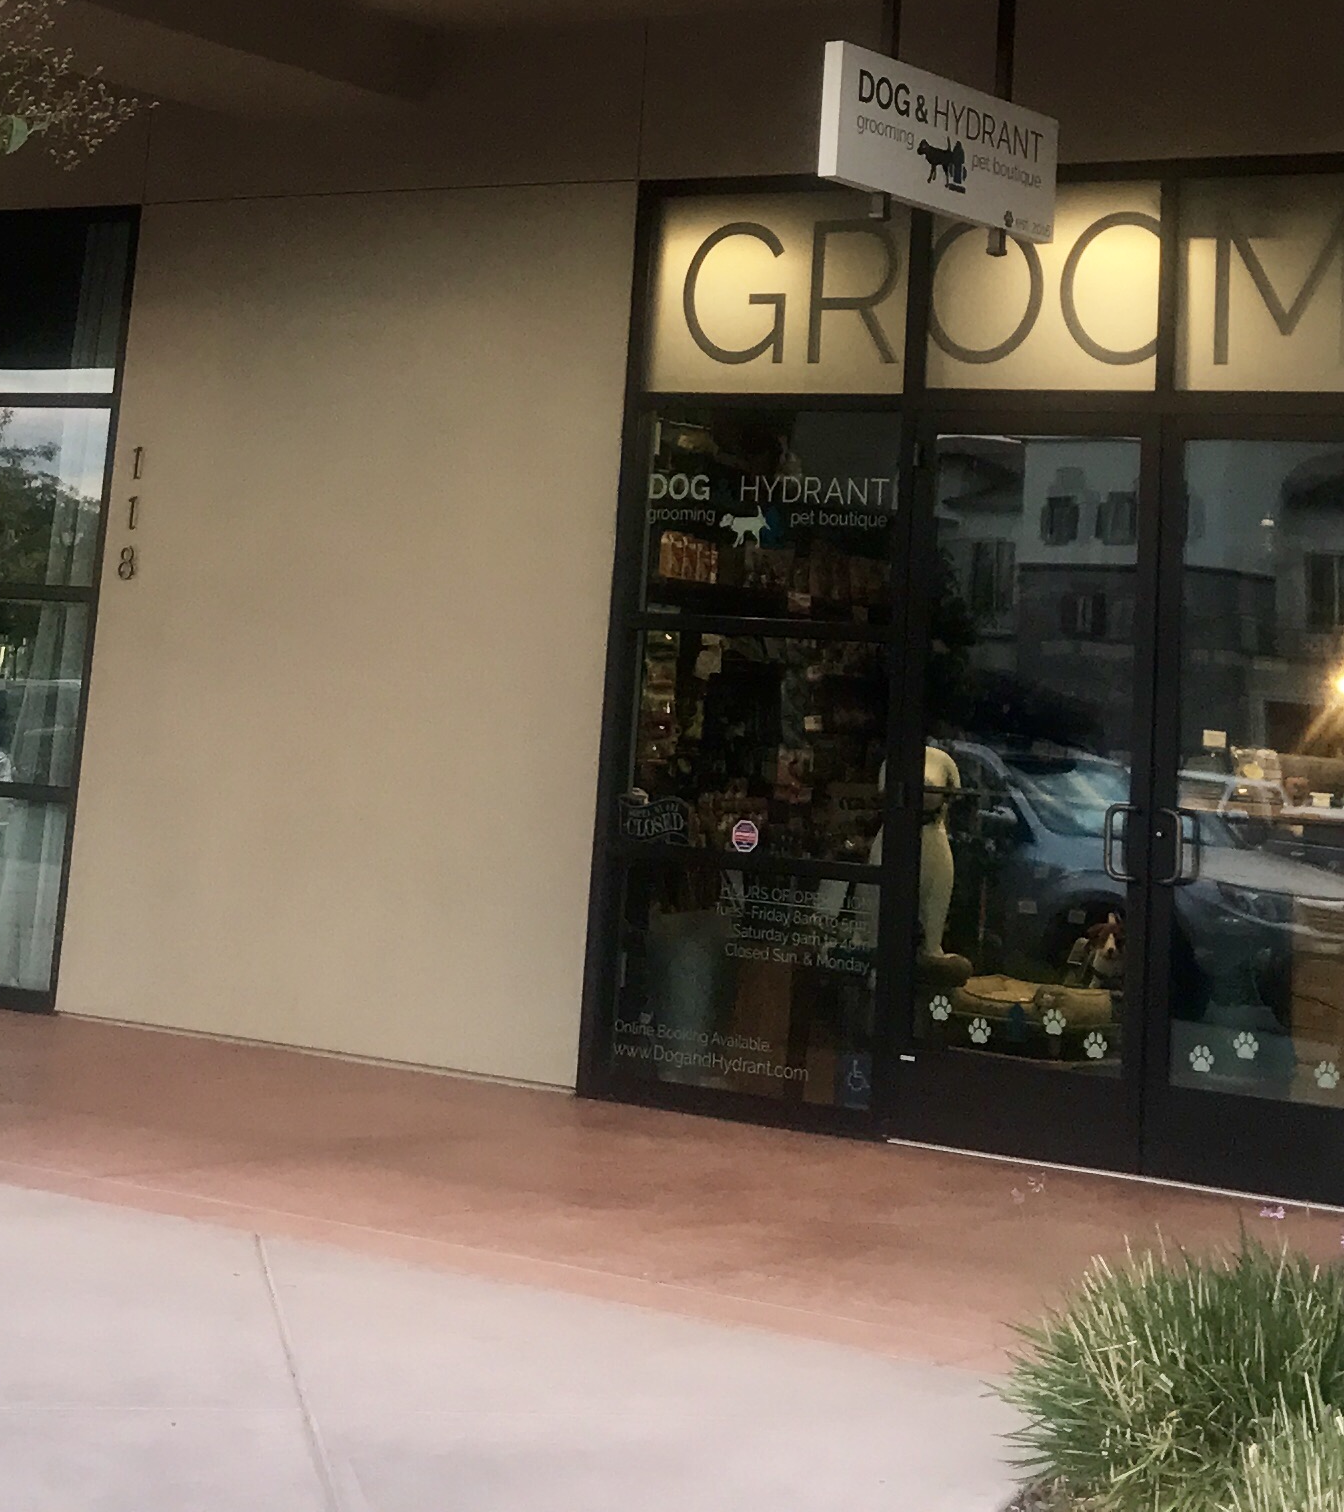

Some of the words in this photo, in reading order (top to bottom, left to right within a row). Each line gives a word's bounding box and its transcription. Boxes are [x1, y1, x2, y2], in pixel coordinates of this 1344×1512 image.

[857, 68, 911, 118] DOG
[913, 94, 929, 125] &
[933, 95, 1044, 163] HYDRANT
[856, 112, 915, 151] grooming
[970, 151, 992, 172] pet
[992, 157, 1043, 189] boutique
[646, 473, 711, 502] DOG
[740, 475, 890, 506] HYDRANT
[647, 507, 717, 526] grooming
[790, 510, 816, 527] pet
[818, 510, 888, 530] boutique
[626, 813, 685, 837] CLOSED
[733, 923, 789, 946] Saturday
[725, 942, 769, 961] Closed
[614, 1018, 655, 1037] Online
[657, 1024, 708, 1046] Booking
